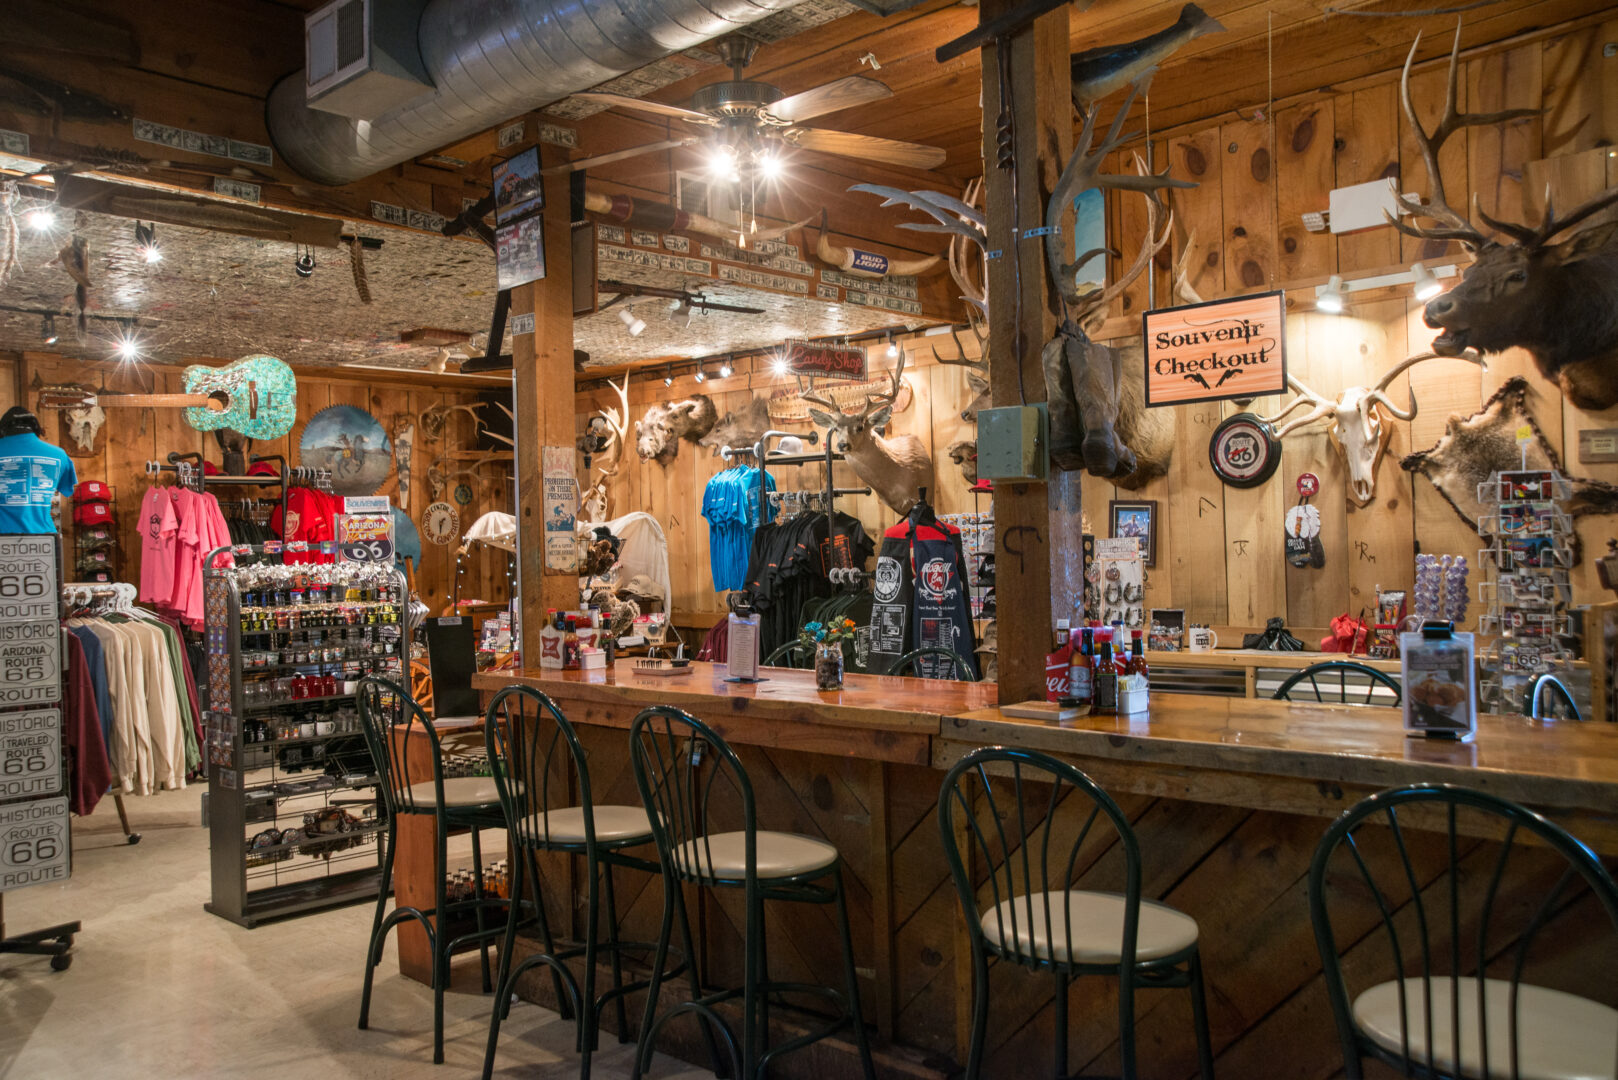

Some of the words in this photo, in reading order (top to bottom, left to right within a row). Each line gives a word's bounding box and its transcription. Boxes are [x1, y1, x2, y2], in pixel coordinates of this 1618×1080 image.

[855, 259, 887, 270] LIGHT
[860, 254, 884, 263] BUD
[1156, 319, 1265, 350] Souvenir
[792, 346, 833, 370] Candy
[834, 351, 864, 373] Shop
[1155, 341, 1274, 375] Checkout
[1232, 438, 1251, 447] ROUTE
[1231, 447, 1251, 462] 66
[348, 522, 386, 530] ARIZONA
[1, 542, 51, 555] STORIC
[352, 541, 383, 559] 66
[0, 575, 44, 597] 66
[0, 624, 55, 639] ISTORIC
[2, 645, 46, 656] ARIZONA
[5, 657, 44, 668] ROUTE
[1519, 654, 1539, 666] 66
[5, 666, 44, 681] 66
[0, 715, 56, 732] ISTORIC
[7, 735, 48, 748] TRAVELED
[6, 747, 43, 759] ROUTE
[4, 756, 46, 774] 66
[1, 804, 65, 824] HISTORIC
[10, 825, 55, 841] ROUTE
[11, 838, 57, 864] 66
[4, 866, 63, 886] ROUTE
